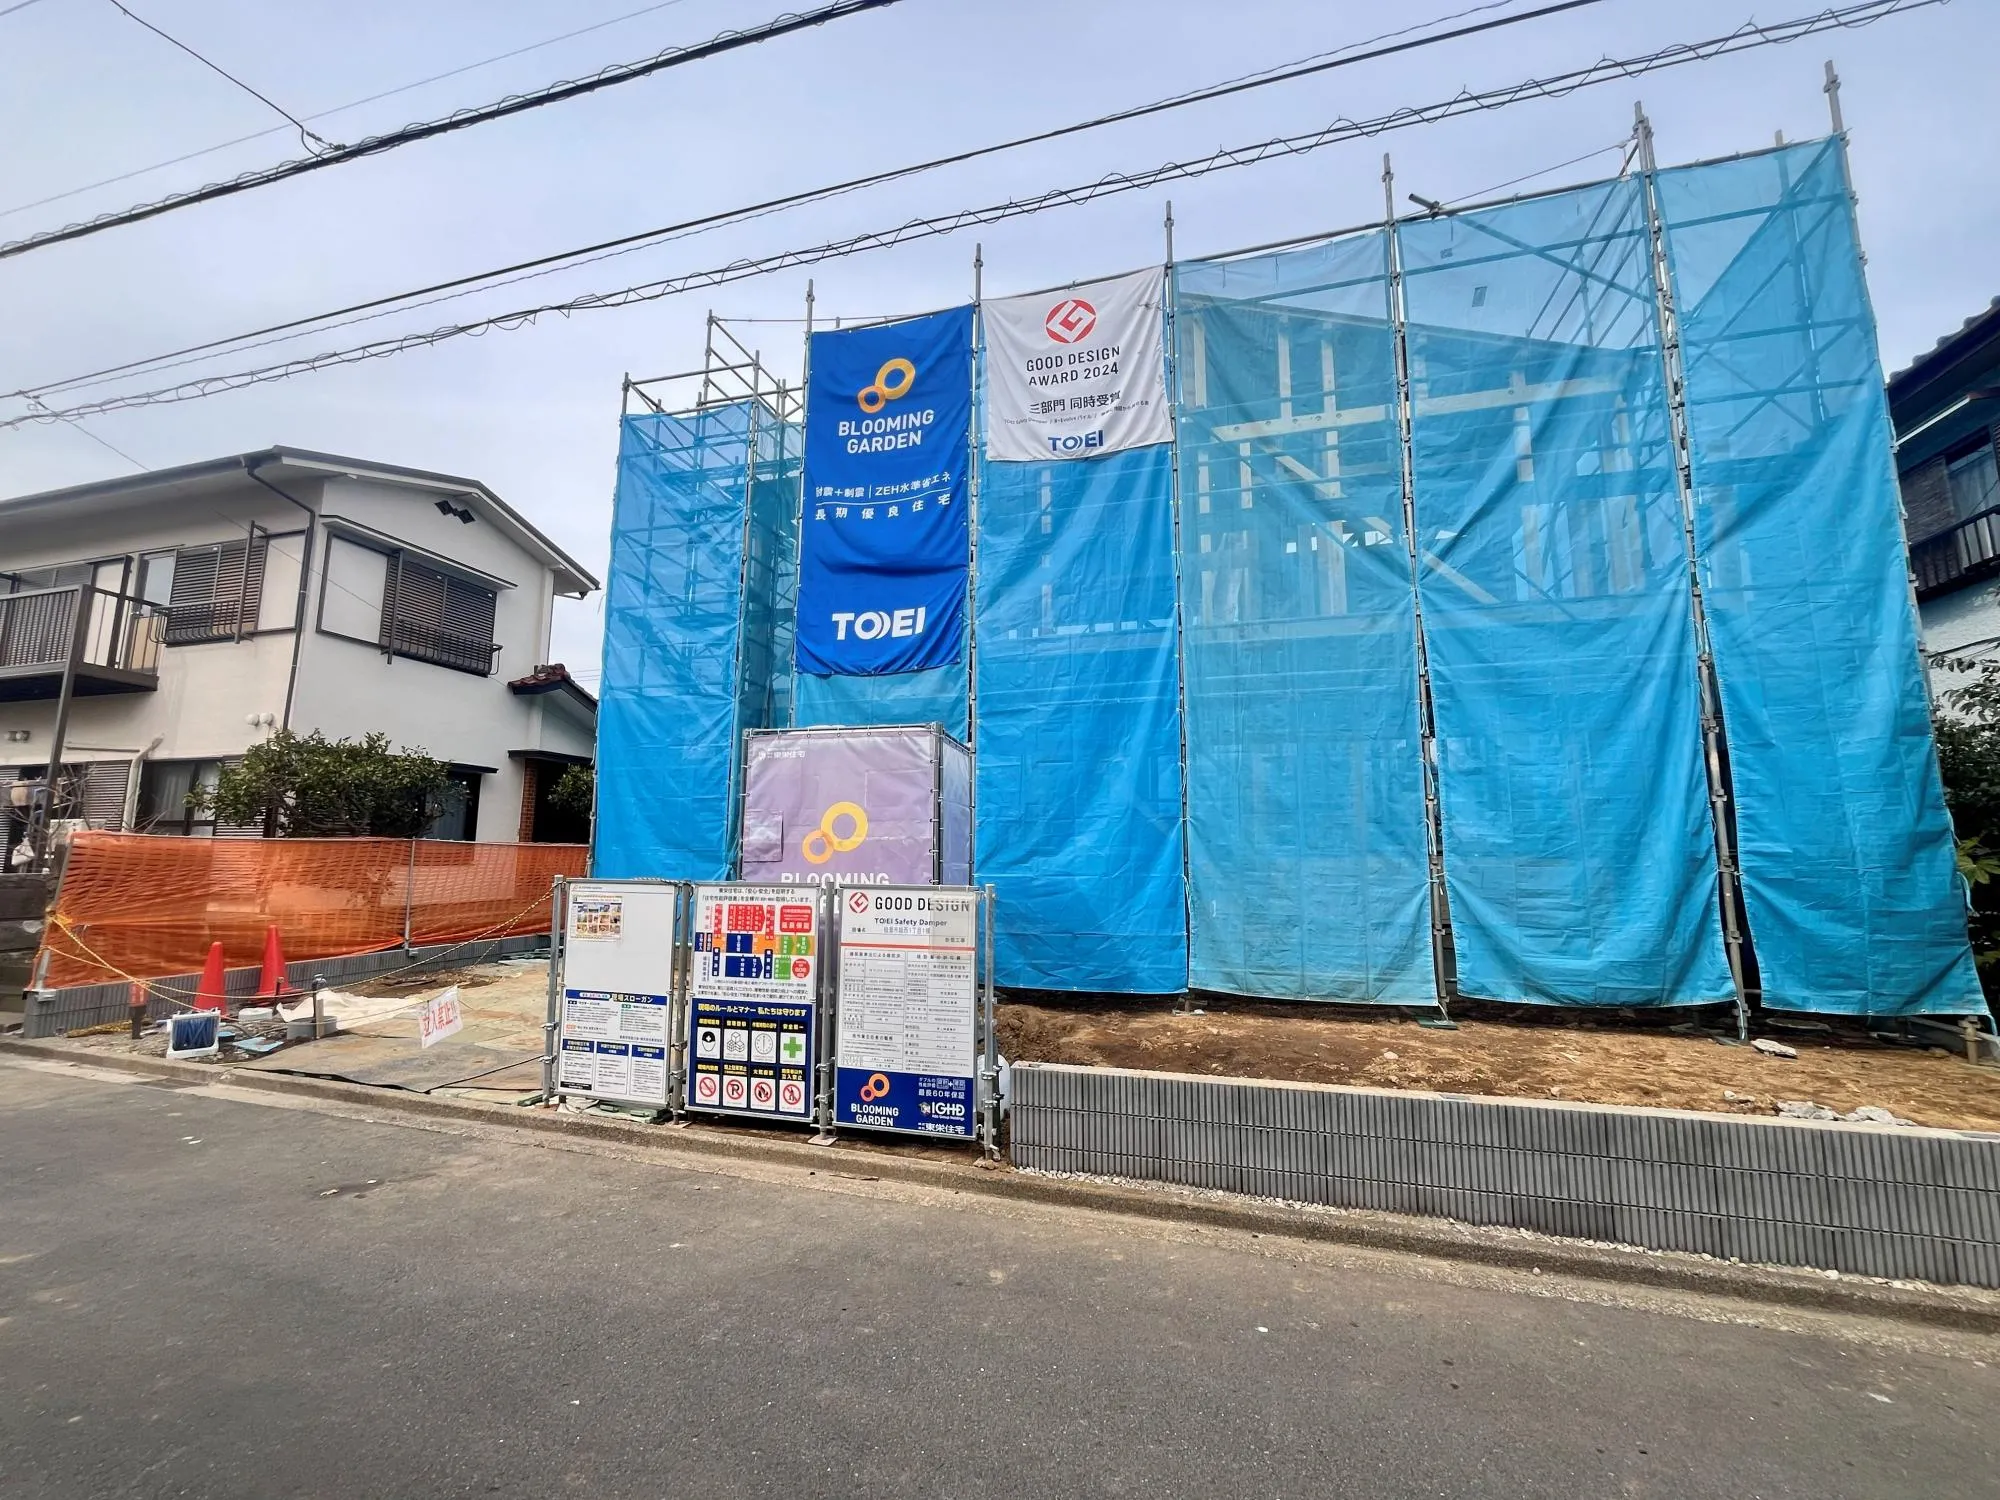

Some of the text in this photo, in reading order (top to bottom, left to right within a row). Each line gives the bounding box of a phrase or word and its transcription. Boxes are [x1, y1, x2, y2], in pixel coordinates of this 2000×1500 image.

[1026, 346, 1120, 372] GOOD DESIGN
[1029, 361, 1119, 386] AWARD 2024
[1029, 390, 1121, 414] 三部門 同時受賞
[838, 409, 935, 437] BLOOMING
[847, 430, 922, 454] GARDEN
[1048, 430, 1104, 451] TOEI
[815, 493, 951, 520] 長期優良住宅
[831, 606, 926, 641] TOEI
[875, 896, 970, 912] GOOD DESIGN
[874, 917, 948, 928] TOEI Safety Damper
[850, 1103, 899, 1116] BLOOMING
[856, 1113, 894, 1127] GARDEN
